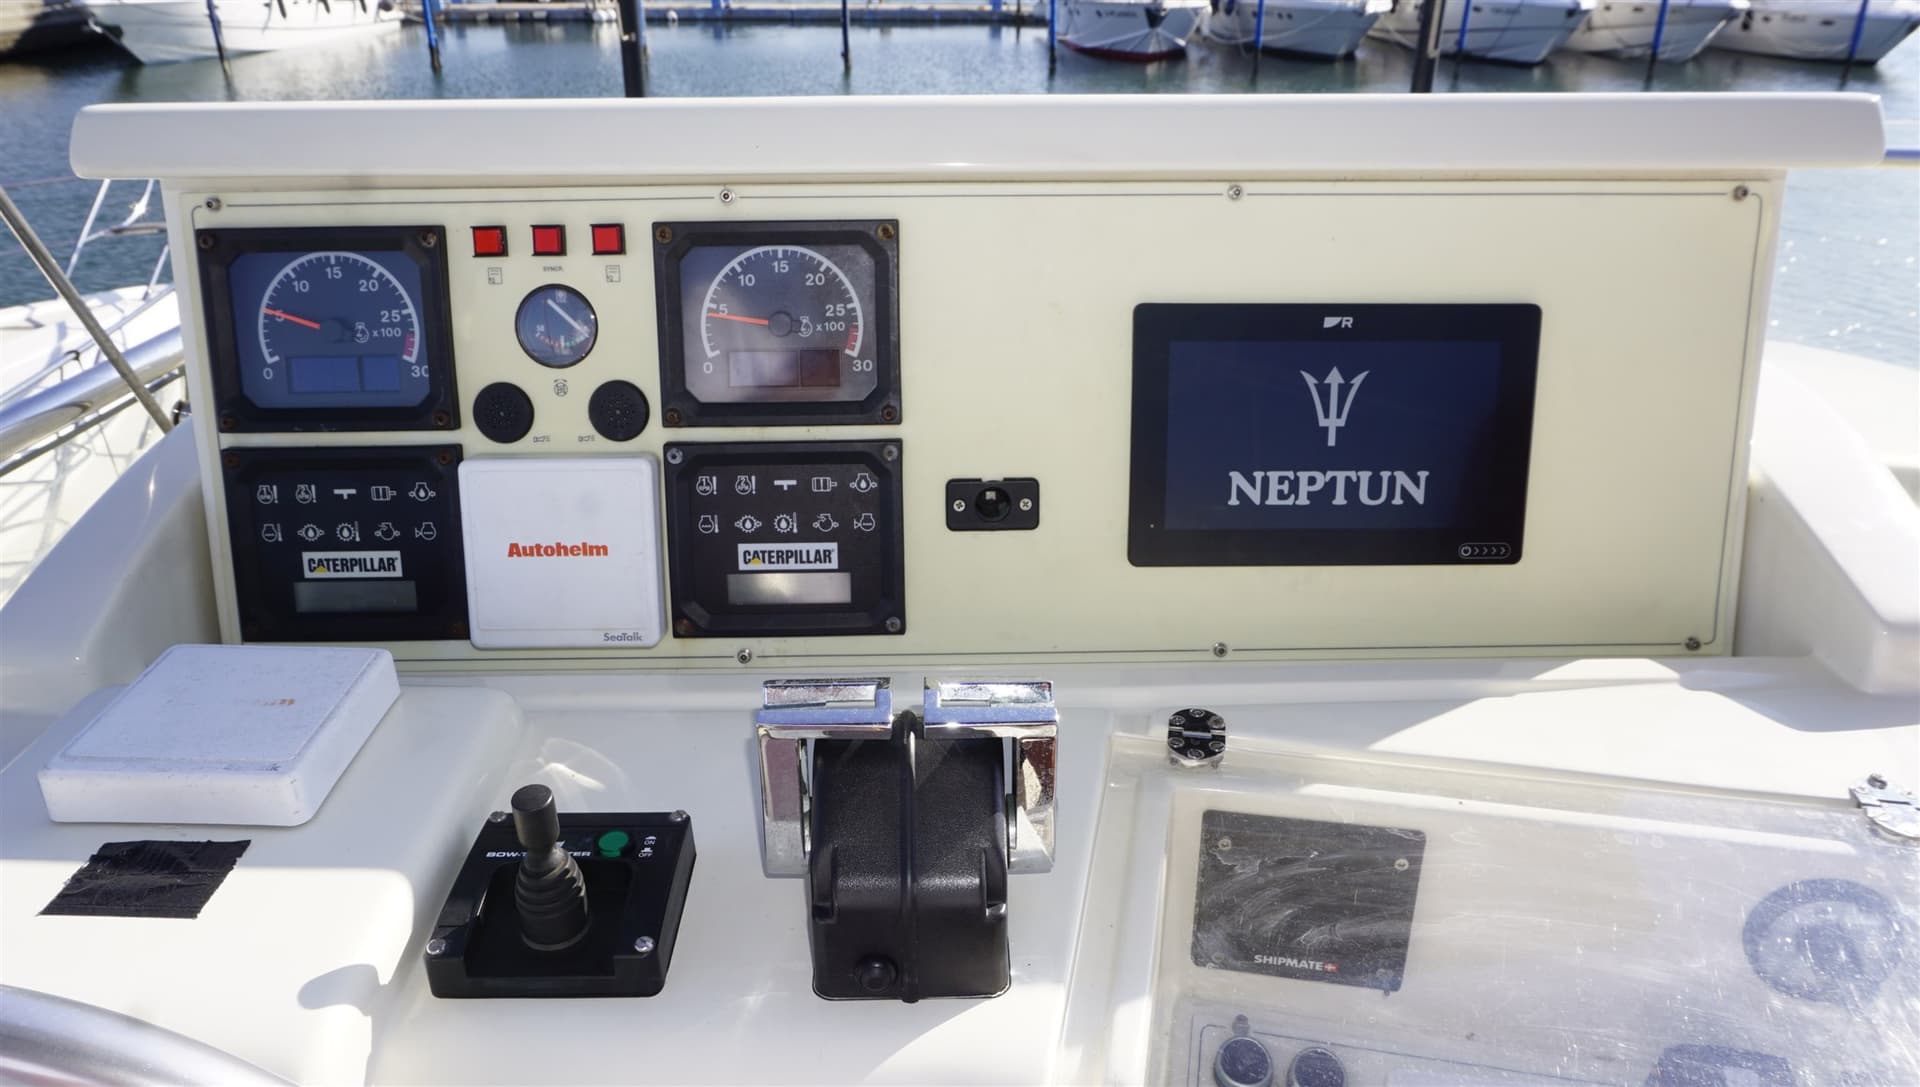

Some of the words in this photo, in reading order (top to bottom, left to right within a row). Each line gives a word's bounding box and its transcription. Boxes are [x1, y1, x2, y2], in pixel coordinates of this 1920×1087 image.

[326, 267, 342, 279] 15
[772, 261, 789, 273] 15
[359, 279, 379, 292] 20
[738, 274, 755, 287] 10
[805, 273, 825, 286] 20
[292, 280, 309, 292] 10
[719, 304, 728, 315] 5
[825, 304, 845, 316] 25
[380, 311, 400, 323] 25
[704, 362, 713, 374] 0
[852, 359, 872, 372] 30
[263, 368, 273, 380] 0
[1227, 470, 1430, 506] NEPTUN
[508, 542, 609, 558] Autohelm
[743, 549, 833, 565] CATERPILLAR
[308, 557, 397, 573] CATERPILLAR
[603, 632, 643, 642] SeaTalk
[1254, 955, 1324, 971] SHIPMATE
